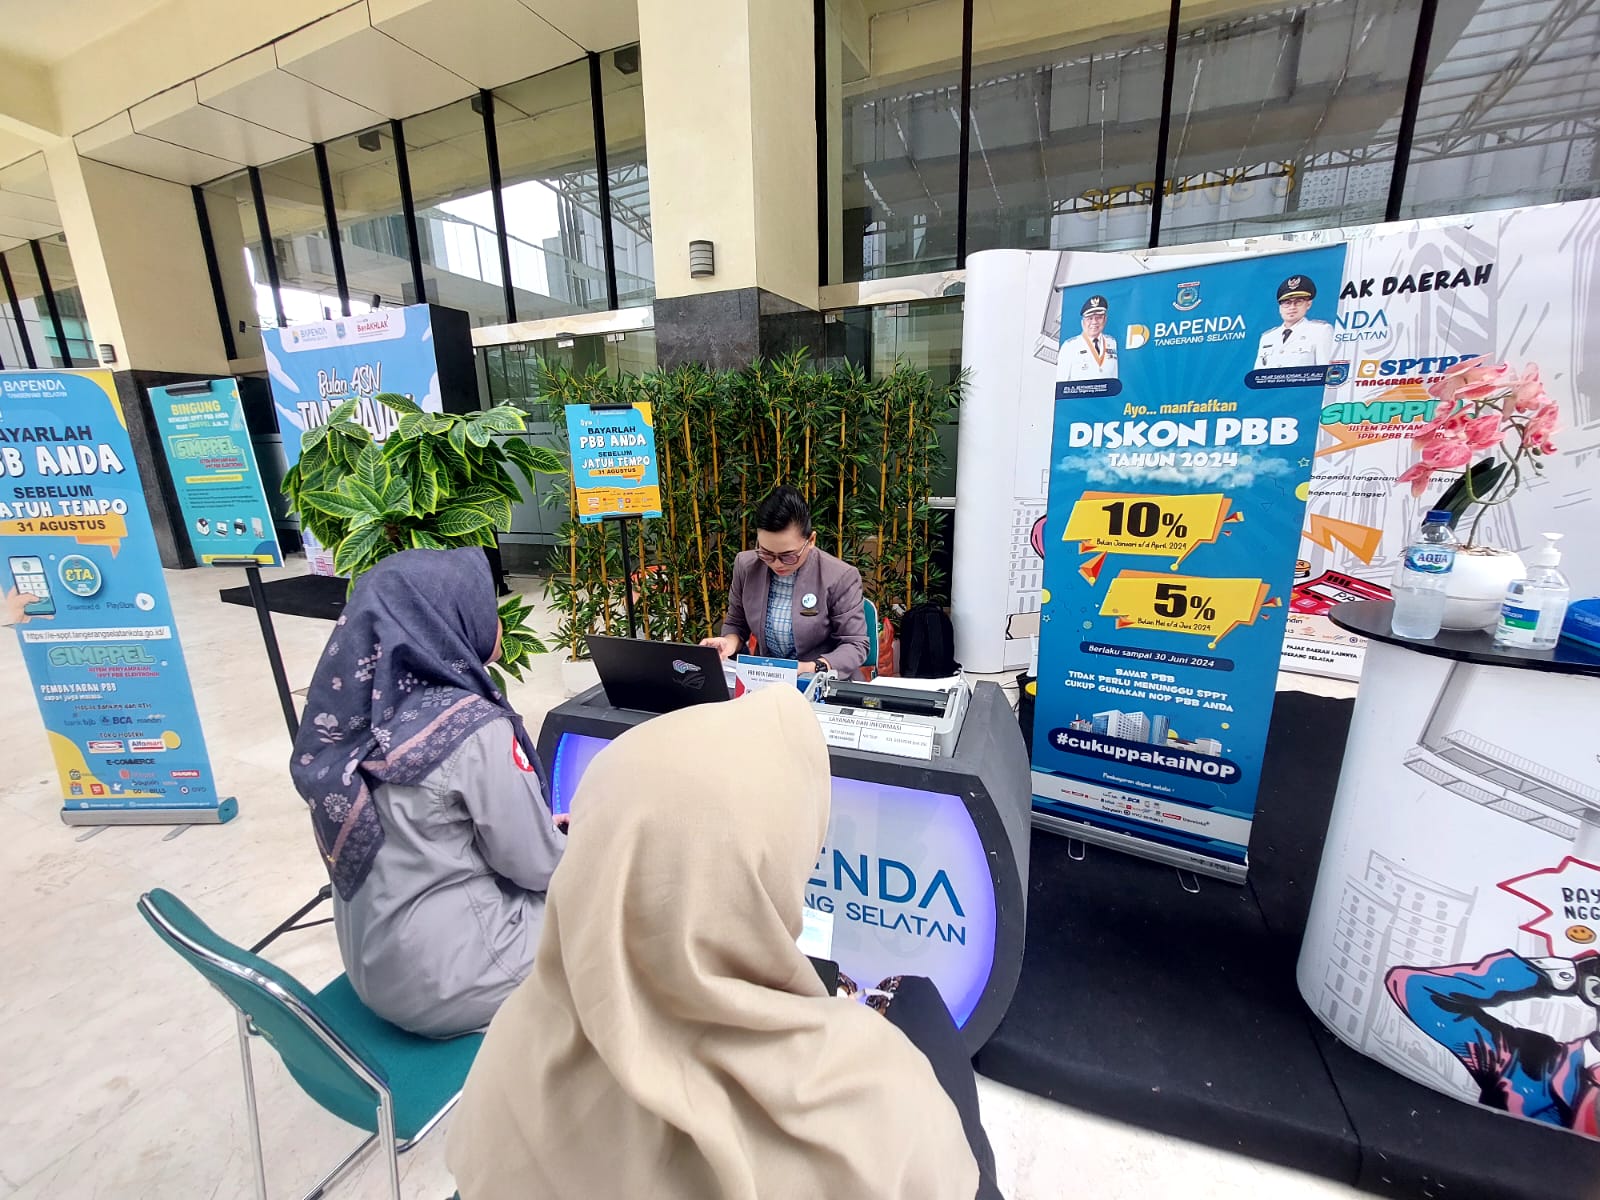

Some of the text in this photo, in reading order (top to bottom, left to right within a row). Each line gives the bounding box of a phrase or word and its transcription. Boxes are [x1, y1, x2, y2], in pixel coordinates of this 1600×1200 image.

[1382, 263, 1493, 296] DAERAH
[1154, 315, 1246, 338] BAPENDA
[1154, 332, 1245, 346] TANGERANG SELATAN
[1335, 330, 1387, 342] SELATAN
[4, 380, 65, 391] BAPENDA
[317, 361, 382, 398] Bulan ASN
[1355, 377, 1423, 386] TANGERANG
[171, 400, 221, 416] BINGUNG
[1124, 402, 1157, 418] Ayo...
[587, 426, 636, 434] BAYARLAH
[1069, 418, 1298, 449] DISKON PBB
[176, 438, 240, 458] SIMPPEL
[580, 434, 646, 449] PBB ANDA
[36, 444, 125, 476] ANDA
[582, 456, 650, 469] JATUH TEMPO
[1108, 452, 1238, 467] TAHUN 2024
[14, 485, 93, 498] SEBELUM
[59, 498, 128, 517] TEMPO
[17, 520, 106, 532] 31 AGUSTUS
[1102, 501, 1188, 538] 10%
[1416, 553, 1448, 563] AQUA
[1154, 583, 1216, 620] 5%
[49, 645, 156, 666] SIMPPEL
[1089, 645, 1120, 655] Berlaku
[1122, 650, 1152, 660] sampai
[1168, 655, 1188, 664] Juni
[1191, 658, 1215, 667] 2024
[1115, 668, 1175, 683] BAYAR PBB
[40, 682, 117, 693] PEMBAYARAN PBB
[1068, 670, 1228, 700] TIDAK PERLU MENUNGGU SPPT
[1065, 679, 1233, 712] CUKUP GUNAKAN NOP PBB ANDA
[113, 716, 133, 725] BCA
[829, 716, 855, 725] LAYANAN
[870, 722, 902, 731] INFORMASI
[1056, 732, 1235, 778] #cukuppakaiNOP
[846, 902, 965, 946] SELATAN
